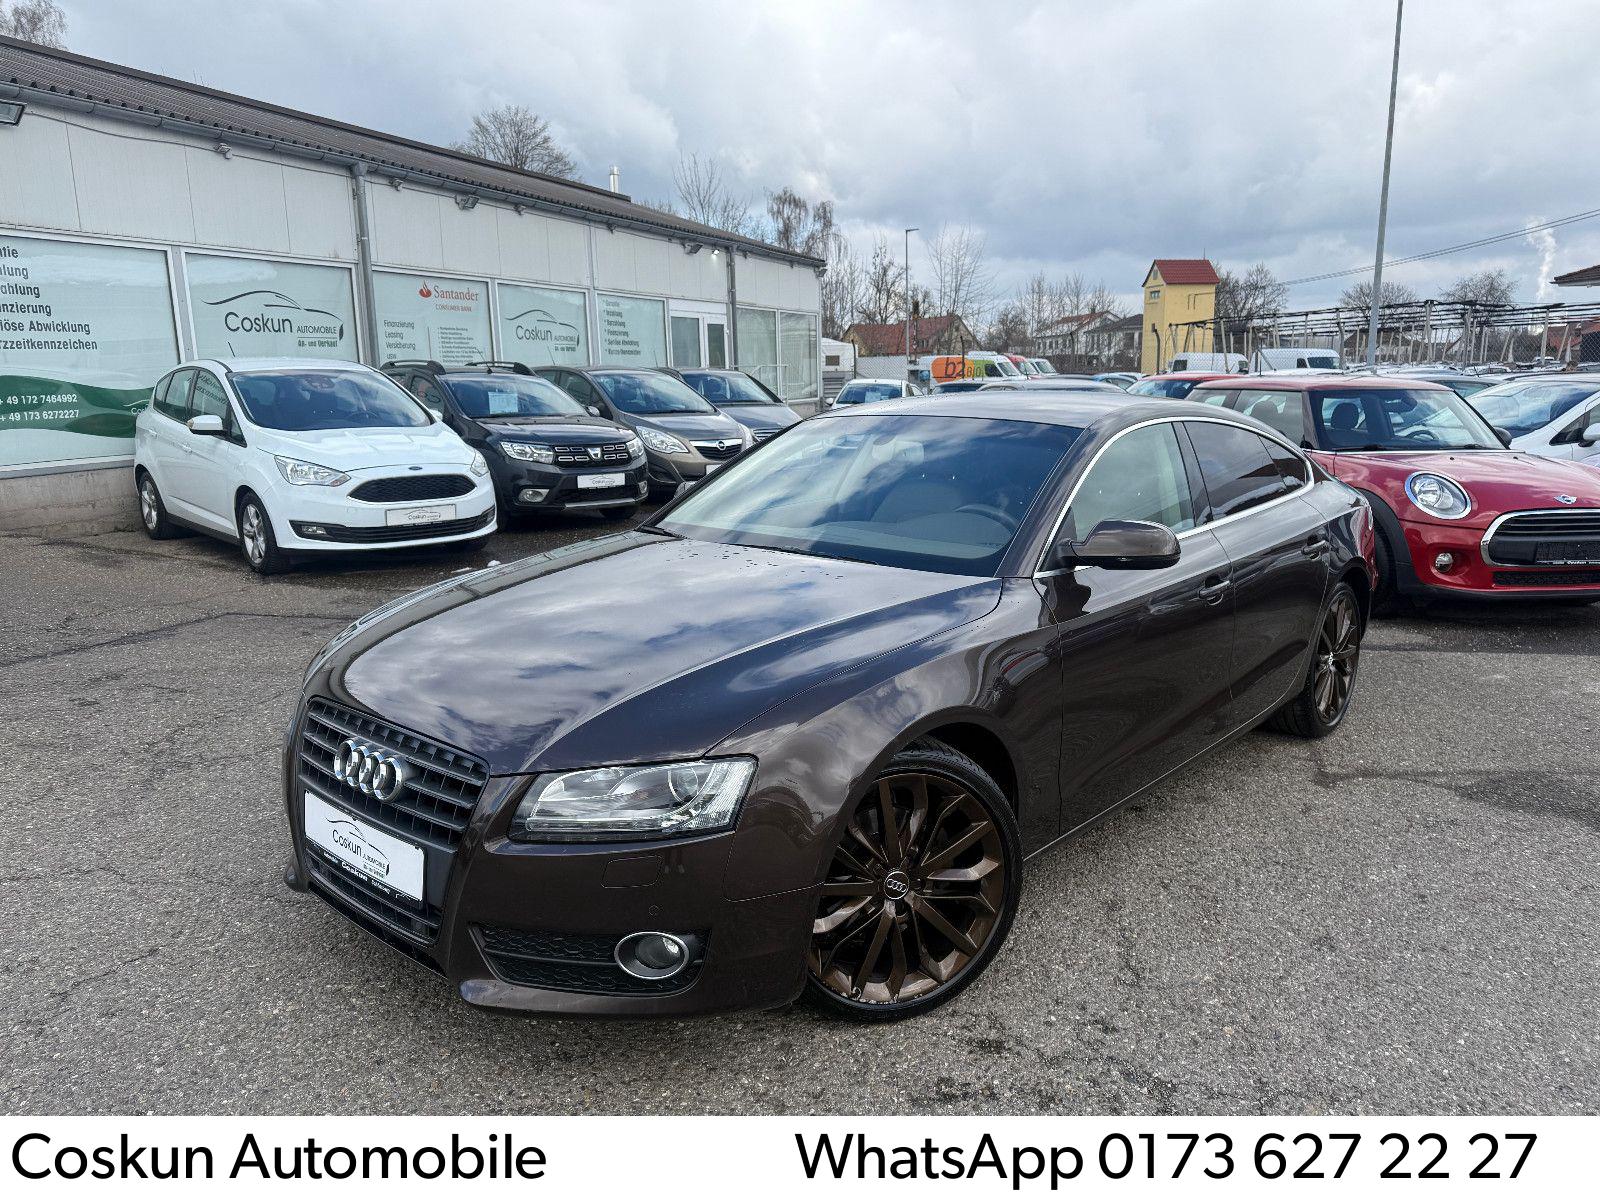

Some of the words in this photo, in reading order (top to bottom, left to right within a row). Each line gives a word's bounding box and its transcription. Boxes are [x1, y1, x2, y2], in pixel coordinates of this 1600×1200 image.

[433, 285, 479, 301] Santander
[29, 320, 91, 335] Abwicklung
[224, 311, 293, 333] Coskun
[383, 319, 415, 329] Finanzierung
[296, 325, 337, 334] AUTOMOBILE
[384, 331, 404, 339] Leasing
[515, 325, 553, 342] Coskun
[6, 395, 19, 405] 49
[21, 395, 39, 405] 172
[40, 394, 78, 404] 7464992
[9, 412, 21, 422] 49
[23, 411, 41, 421] 173
[42, 410, 80, 419] 6272227
[332, 829, 362, 857] Coskun
